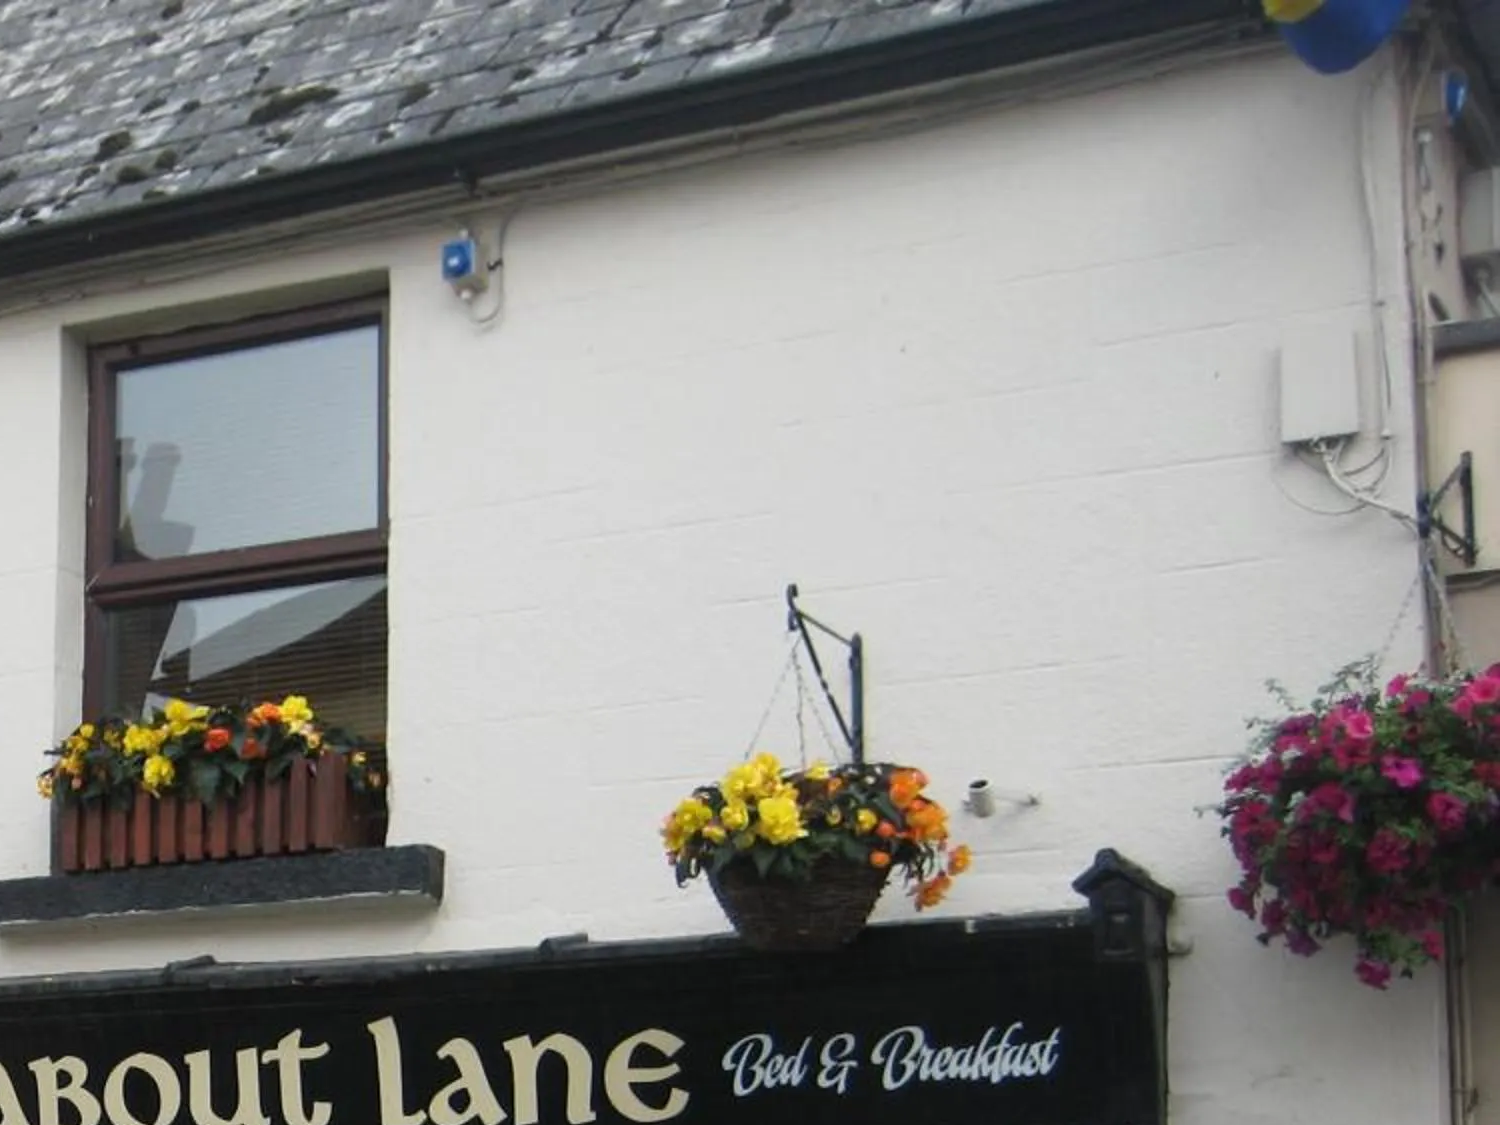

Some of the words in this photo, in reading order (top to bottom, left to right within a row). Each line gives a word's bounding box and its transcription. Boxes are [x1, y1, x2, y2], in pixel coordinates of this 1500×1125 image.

[721, 1033, 811, 1096] Bed
[816, 1033, 858, 1094] &
[870, 1021, 1062, 1091] Breakfast
